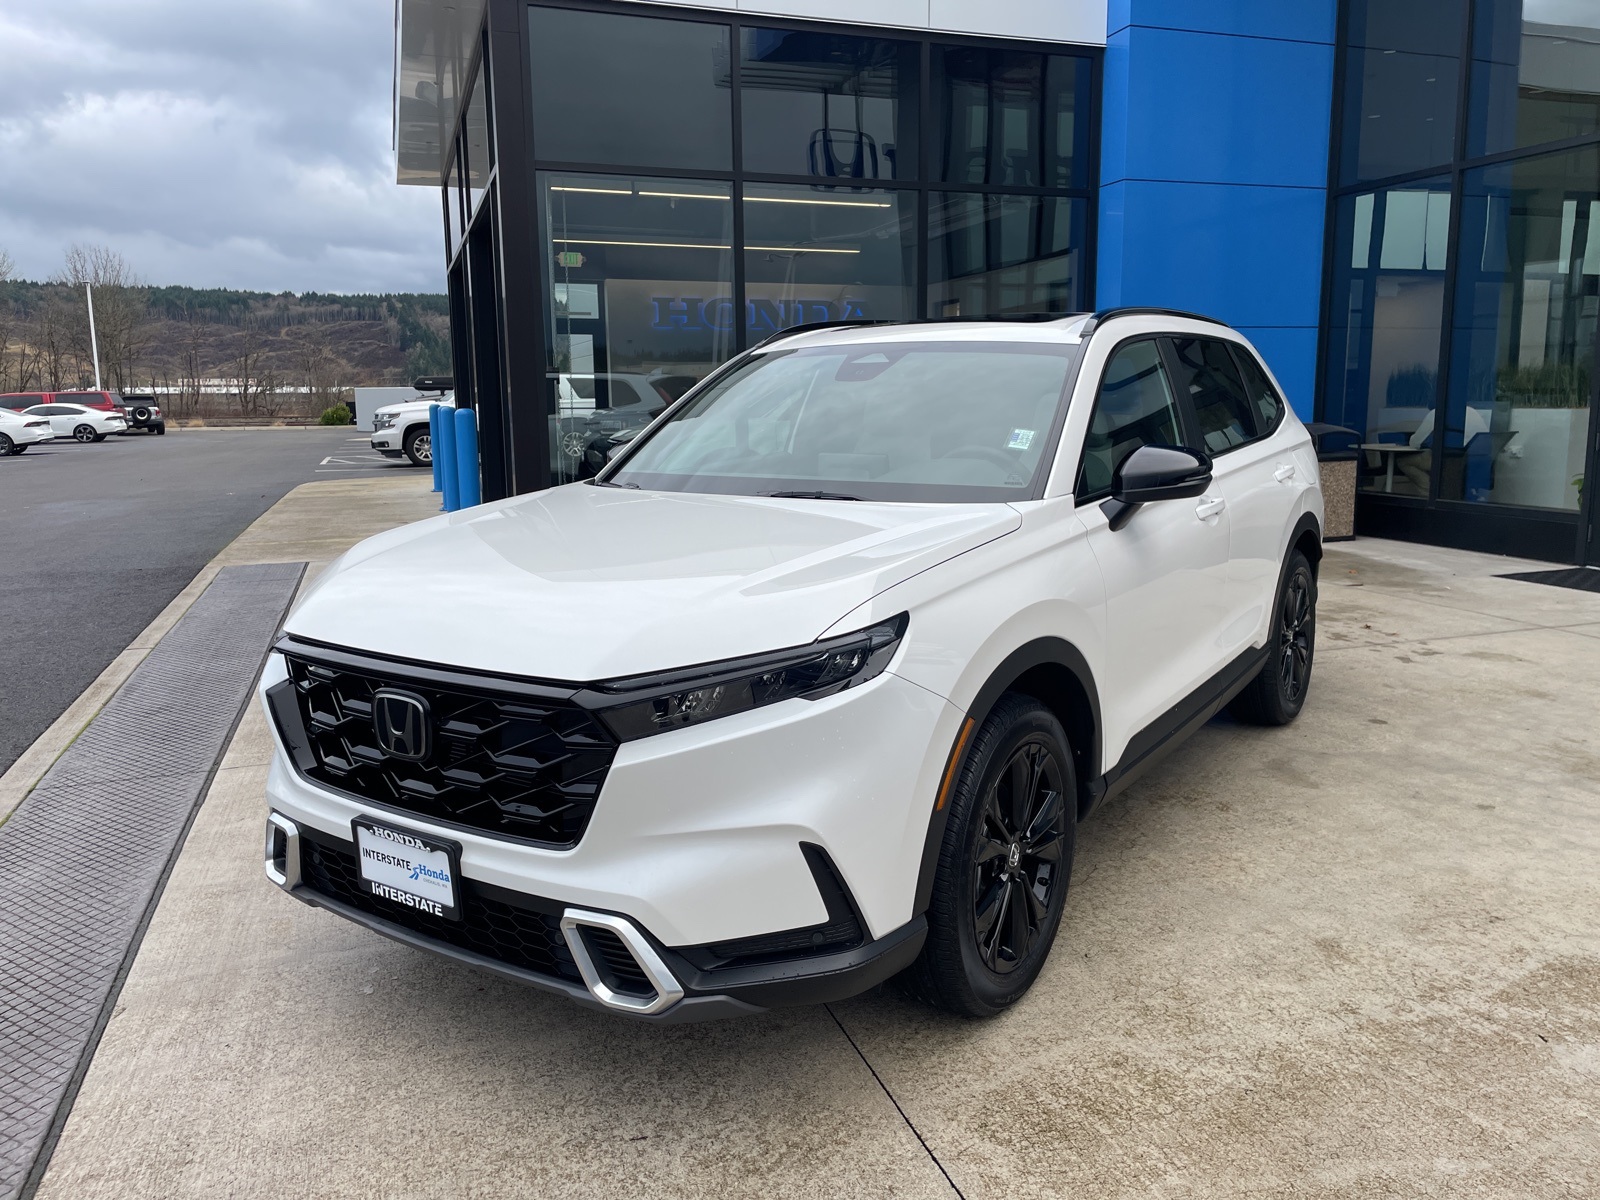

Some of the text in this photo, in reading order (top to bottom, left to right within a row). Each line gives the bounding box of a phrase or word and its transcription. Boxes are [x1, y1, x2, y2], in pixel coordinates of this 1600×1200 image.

[651, 297, 868, 331] HONDA
[373, 826, 427, 851] HONDA
[362, 847, 450, 882] INTERSTATE Honda
[371, 881, 443, 916] INTERSTATE
